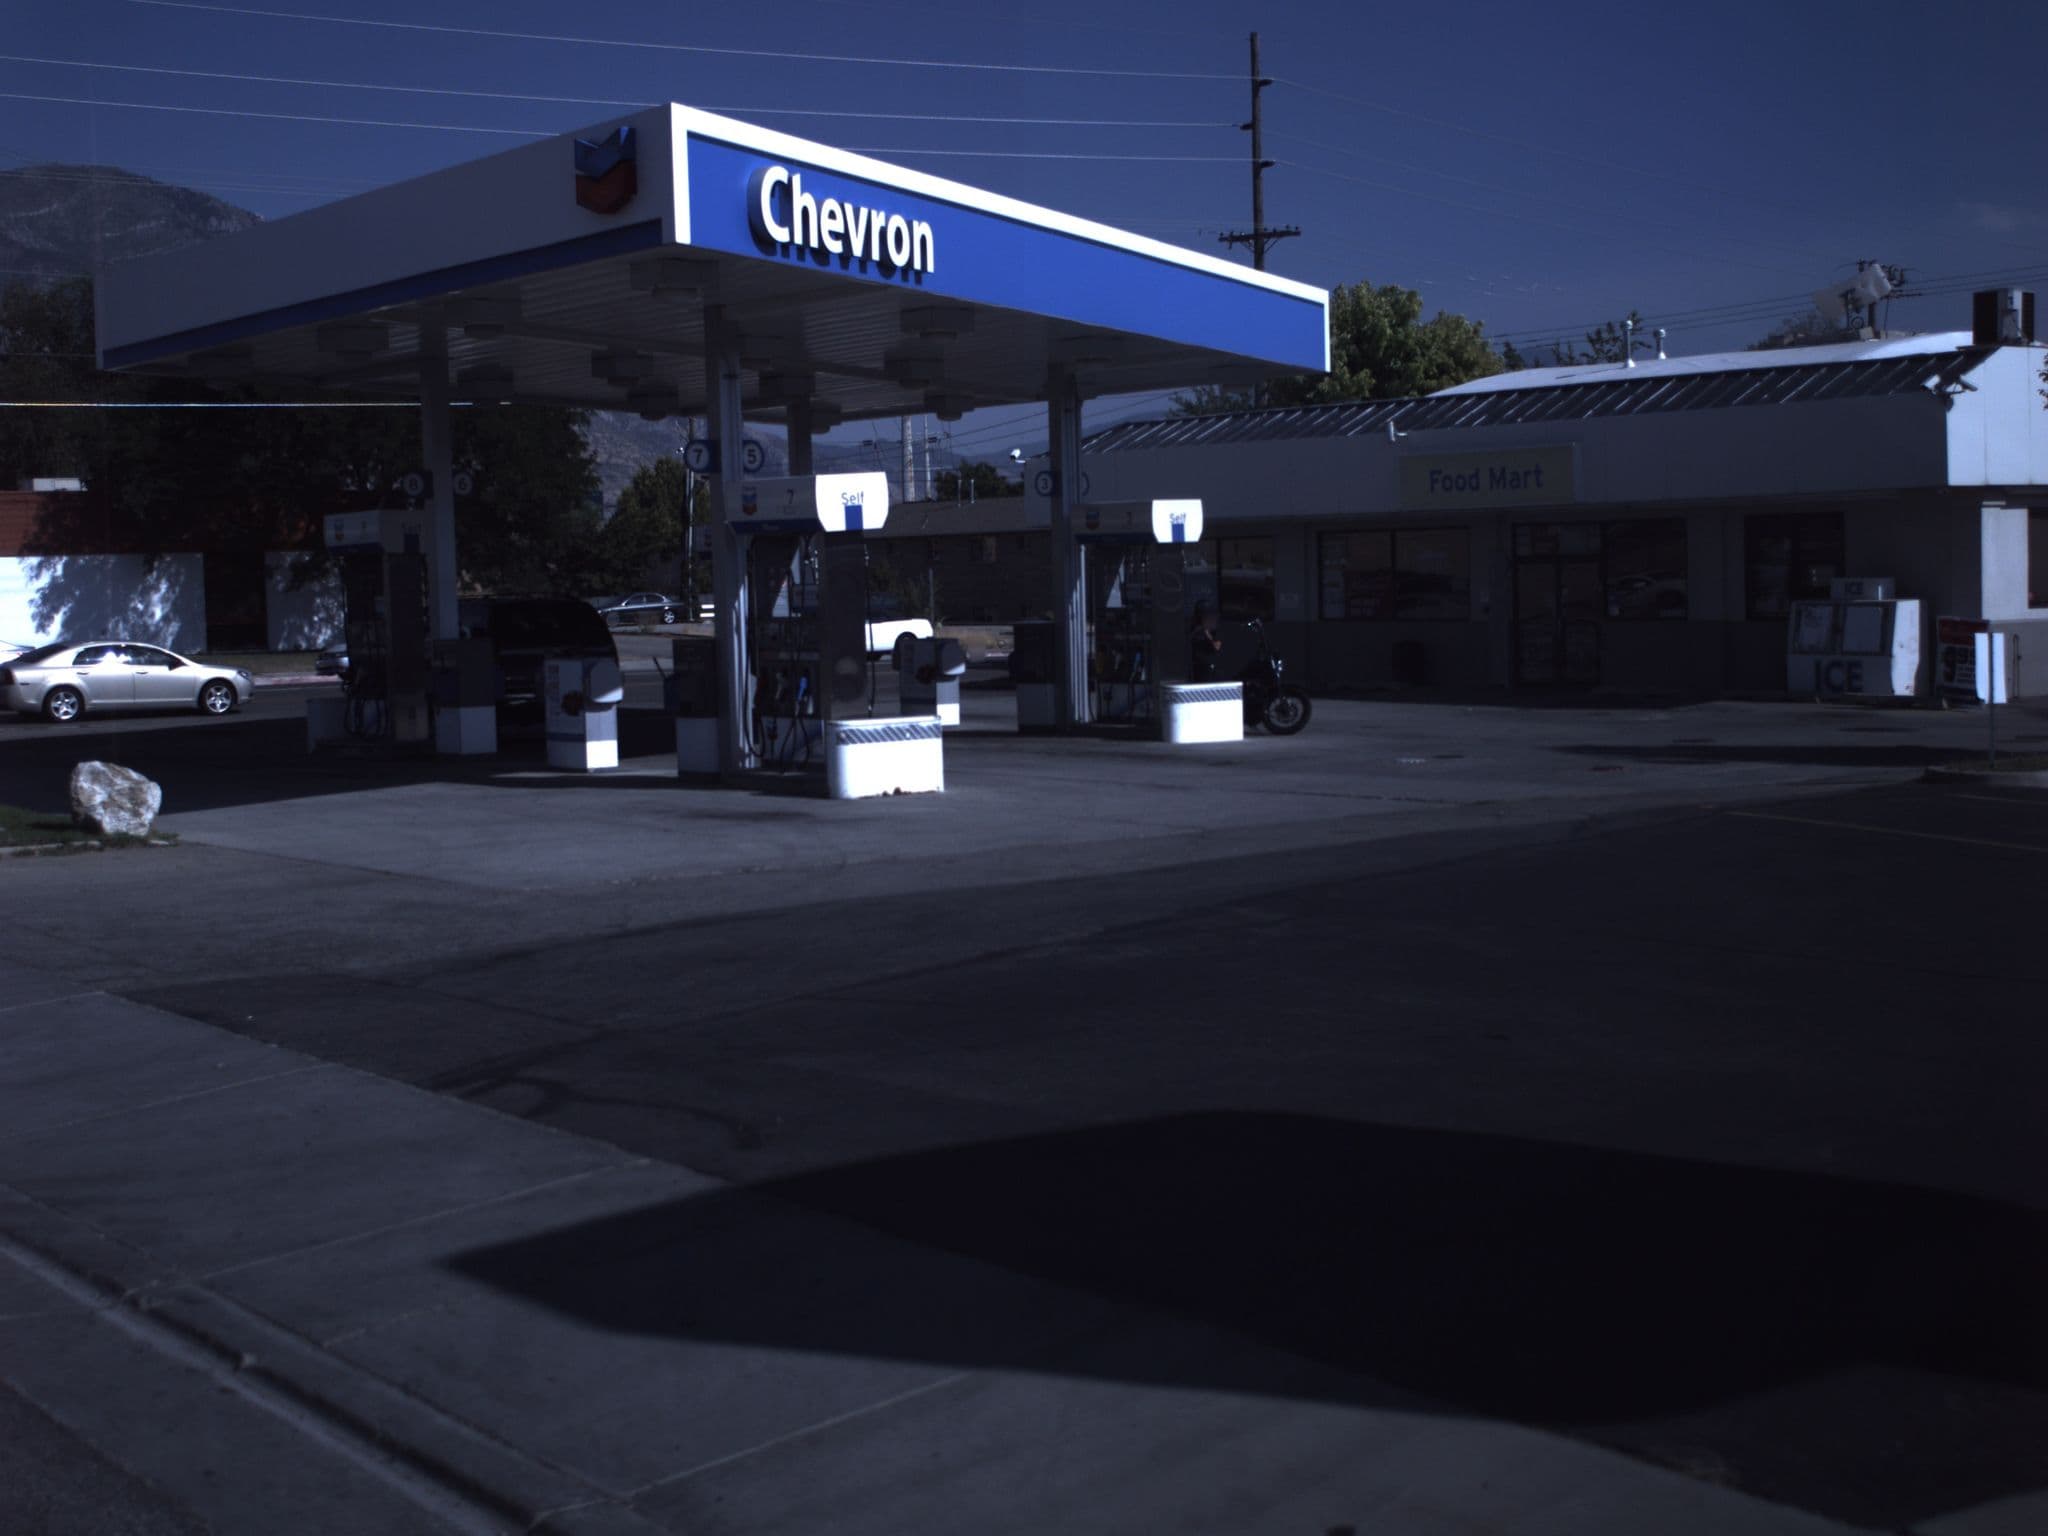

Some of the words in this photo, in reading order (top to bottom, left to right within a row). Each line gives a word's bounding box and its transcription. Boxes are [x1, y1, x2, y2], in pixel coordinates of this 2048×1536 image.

[760, 165, 934, 274] Chevron
[693, 449, 703, 465] 7
[747, 448, 757, 465] 5
[1429, 466, 1480, 493] Food
[1488, 463, 1544, 490] Mart
[841, 490, 864, 505] Self
[1815, 661, 1863, 693] ICE
